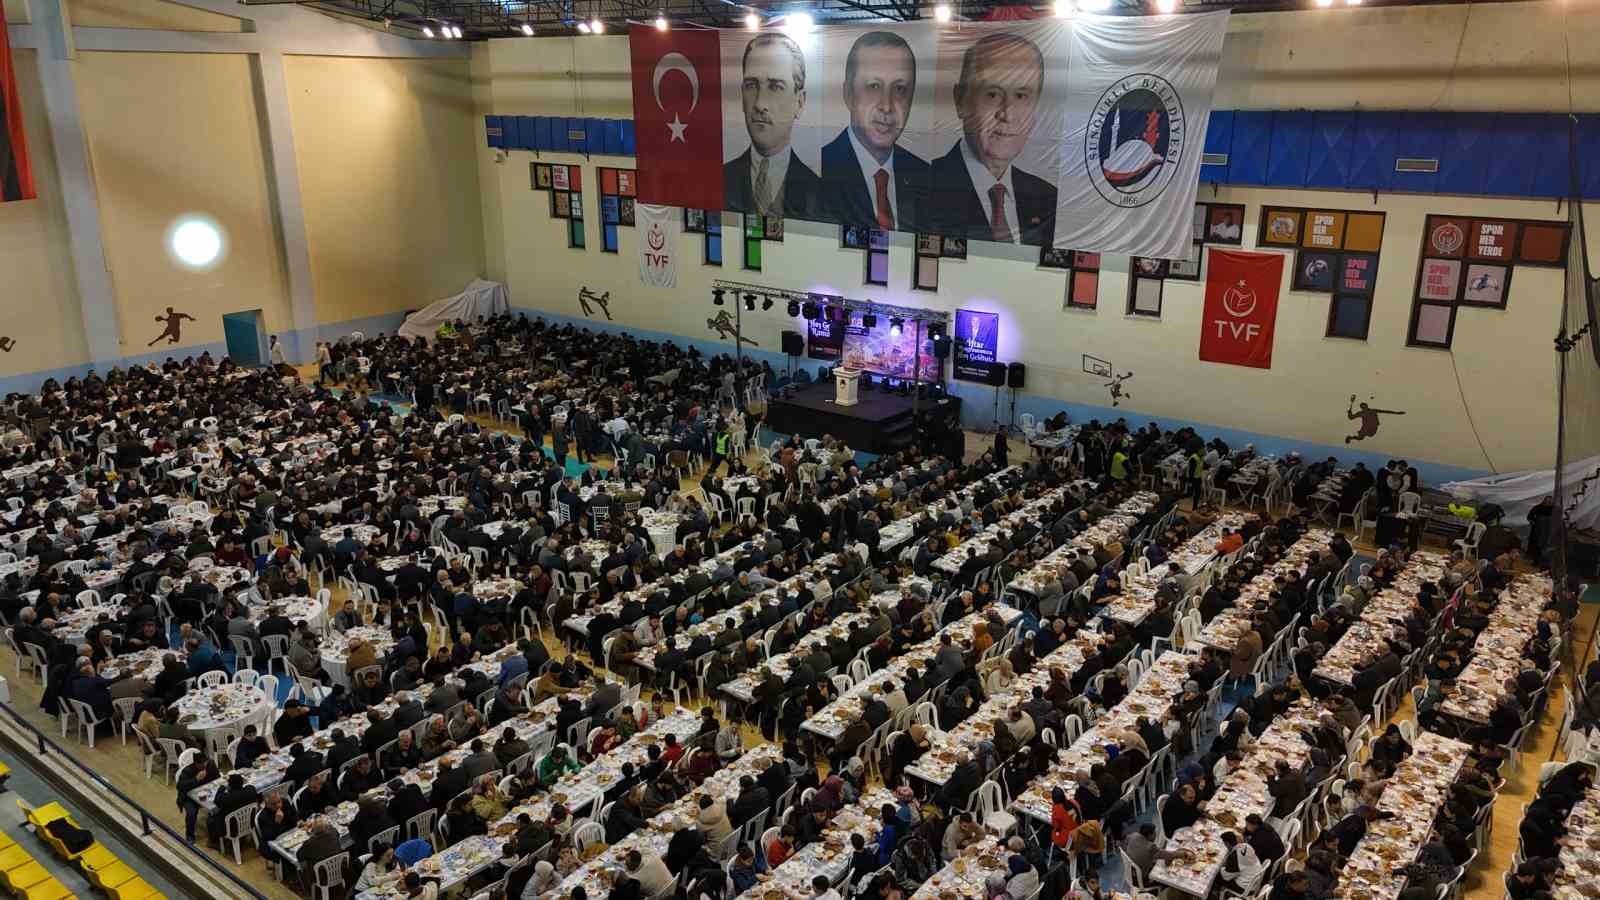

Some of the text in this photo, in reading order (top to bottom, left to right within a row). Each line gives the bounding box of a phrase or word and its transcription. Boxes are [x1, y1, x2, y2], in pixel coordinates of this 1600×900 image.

[1481, 223, 1504, 235] SPOR
[1480, 234, 1496, 245] HER
[1478, 245, 1504, 256] YERDE
[644, 253, 669, 268] TVF
[1214, 319, 1261, 342] TVF
